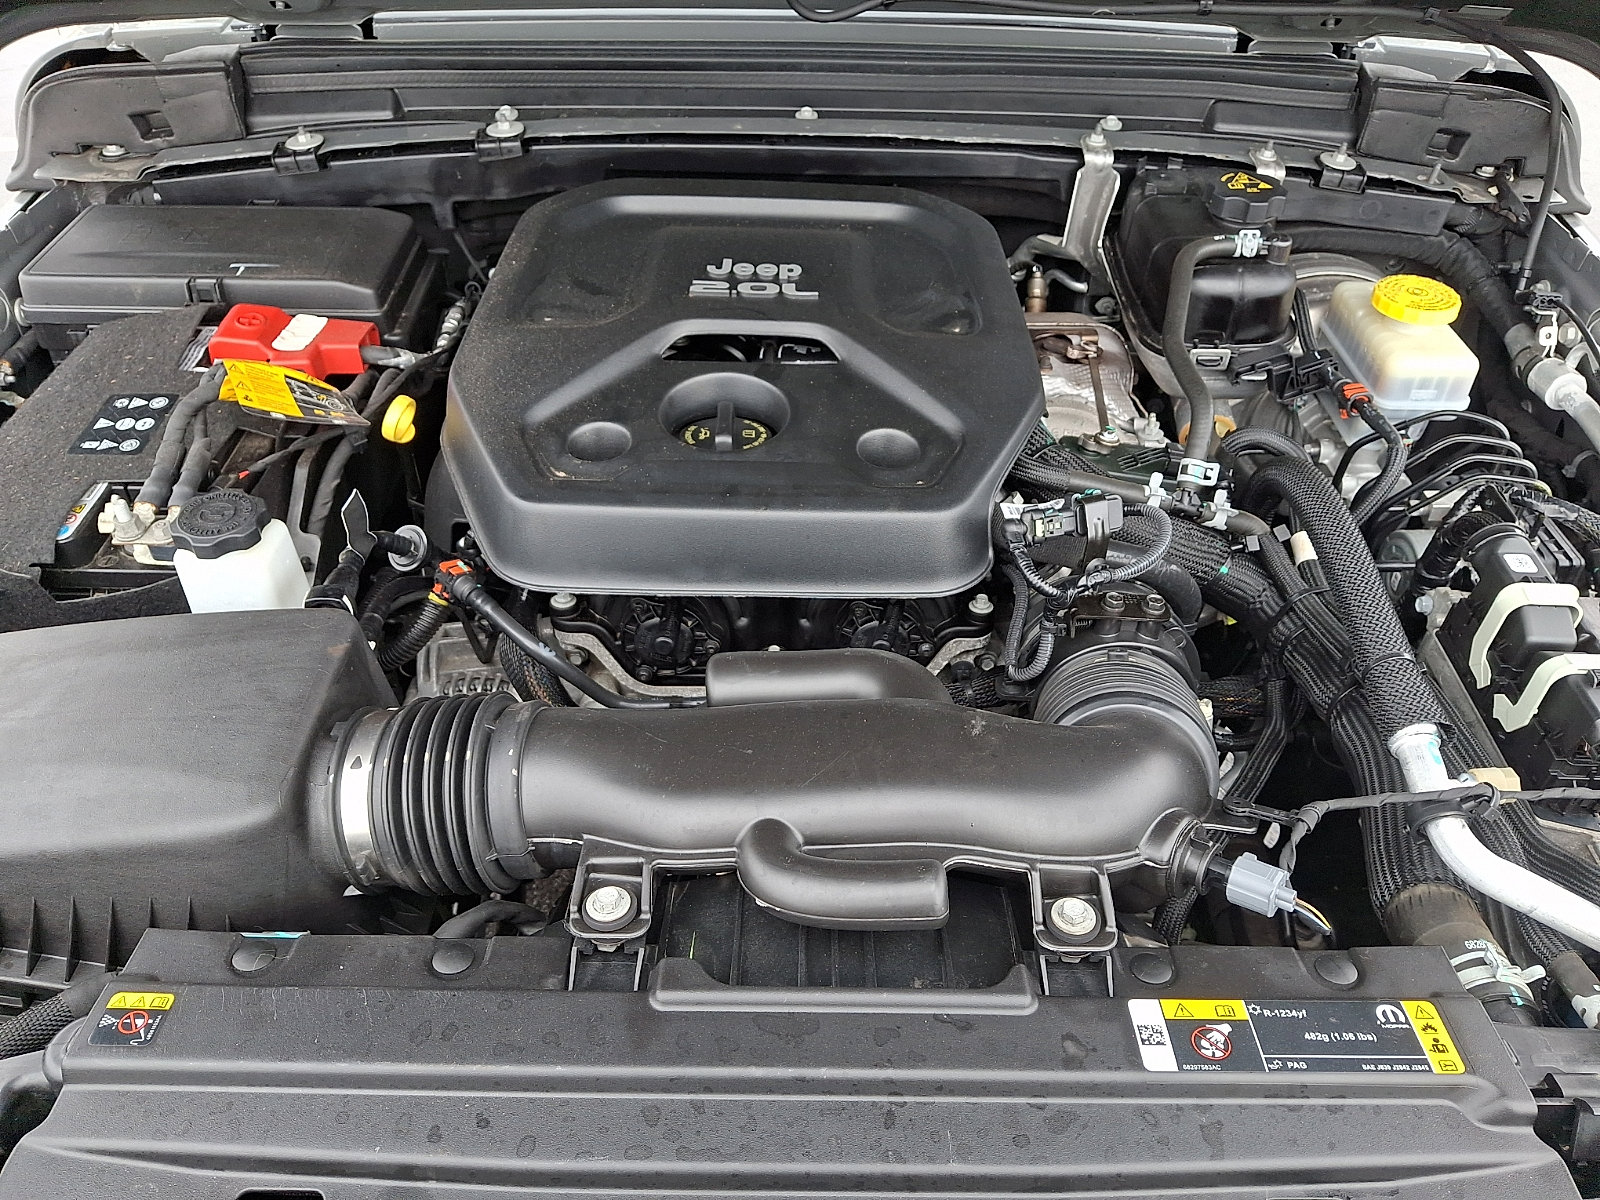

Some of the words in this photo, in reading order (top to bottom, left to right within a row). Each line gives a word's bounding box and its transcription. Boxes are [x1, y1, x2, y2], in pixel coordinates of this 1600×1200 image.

[706, 258, 802, 280] Jeep
[689, 280, 819, 298] 2.0L
[1263, 1009, 1307, 1019] R-1234yf
[1304, 1031, 1329, 1042] 482g
[1356, 1031, 1378, 1042] lbs)
[1286, 1061, 1308, 1069] PAG
